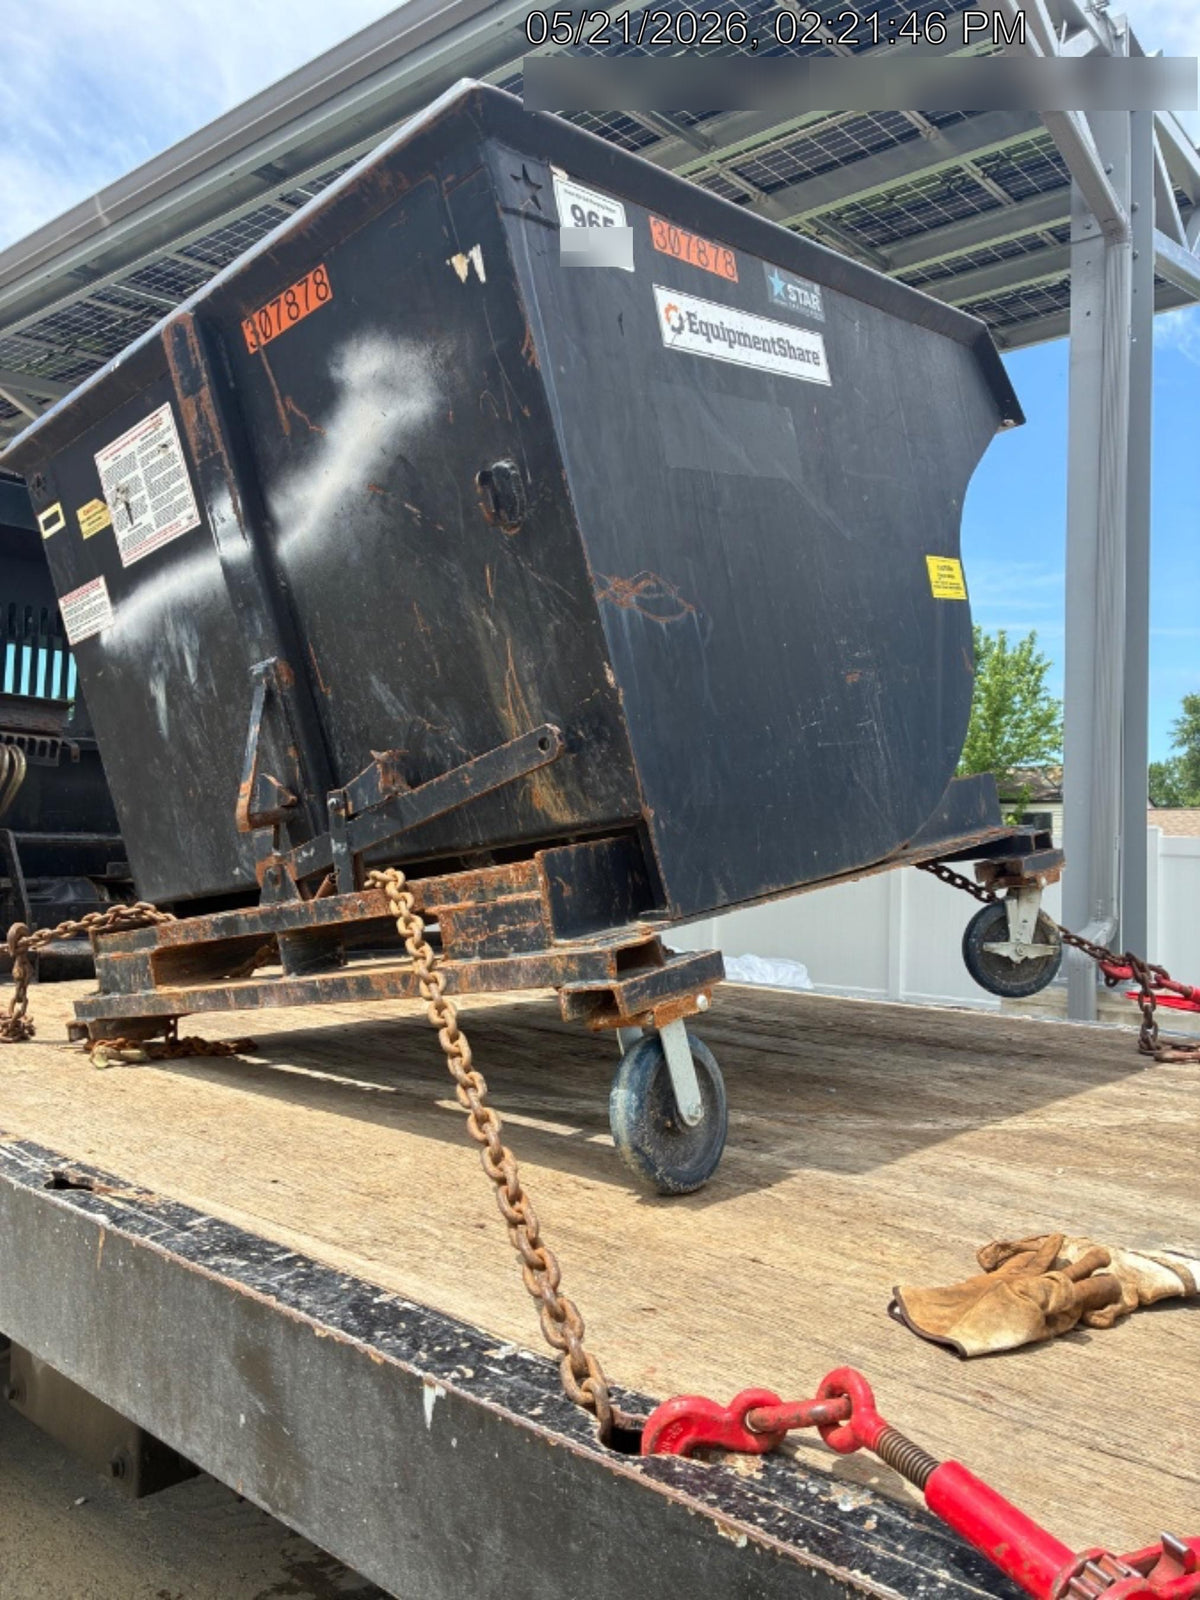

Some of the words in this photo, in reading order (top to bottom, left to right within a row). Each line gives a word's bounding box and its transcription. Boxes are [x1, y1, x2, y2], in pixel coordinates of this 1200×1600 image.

[652, 219, 736, 278] 307878
[787, 284, 823, 312] STAR
[685, 310, 821, 367] EquipmentShare
